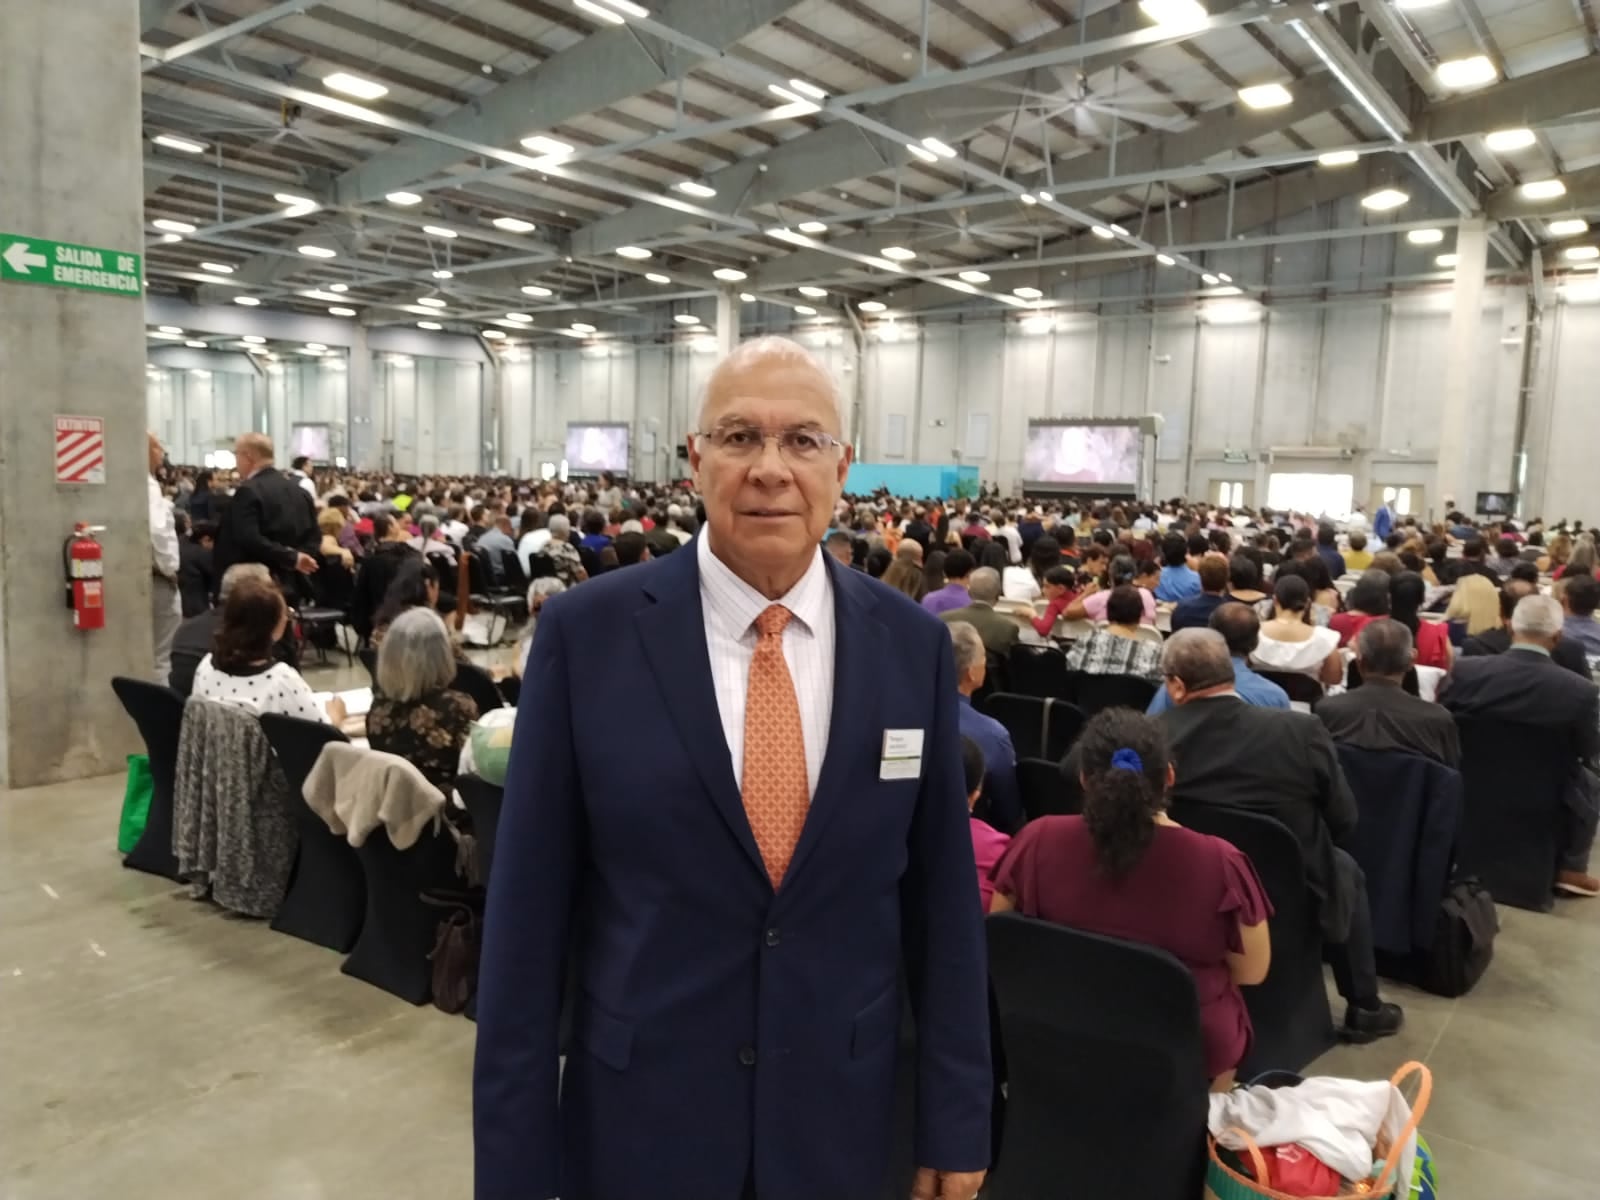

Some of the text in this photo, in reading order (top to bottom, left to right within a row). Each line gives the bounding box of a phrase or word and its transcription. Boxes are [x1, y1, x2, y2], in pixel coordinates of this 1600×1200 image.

[56, 246, 135, 273] SALIDA DE
[53, 264, 139, 292] EMERGENCIA
